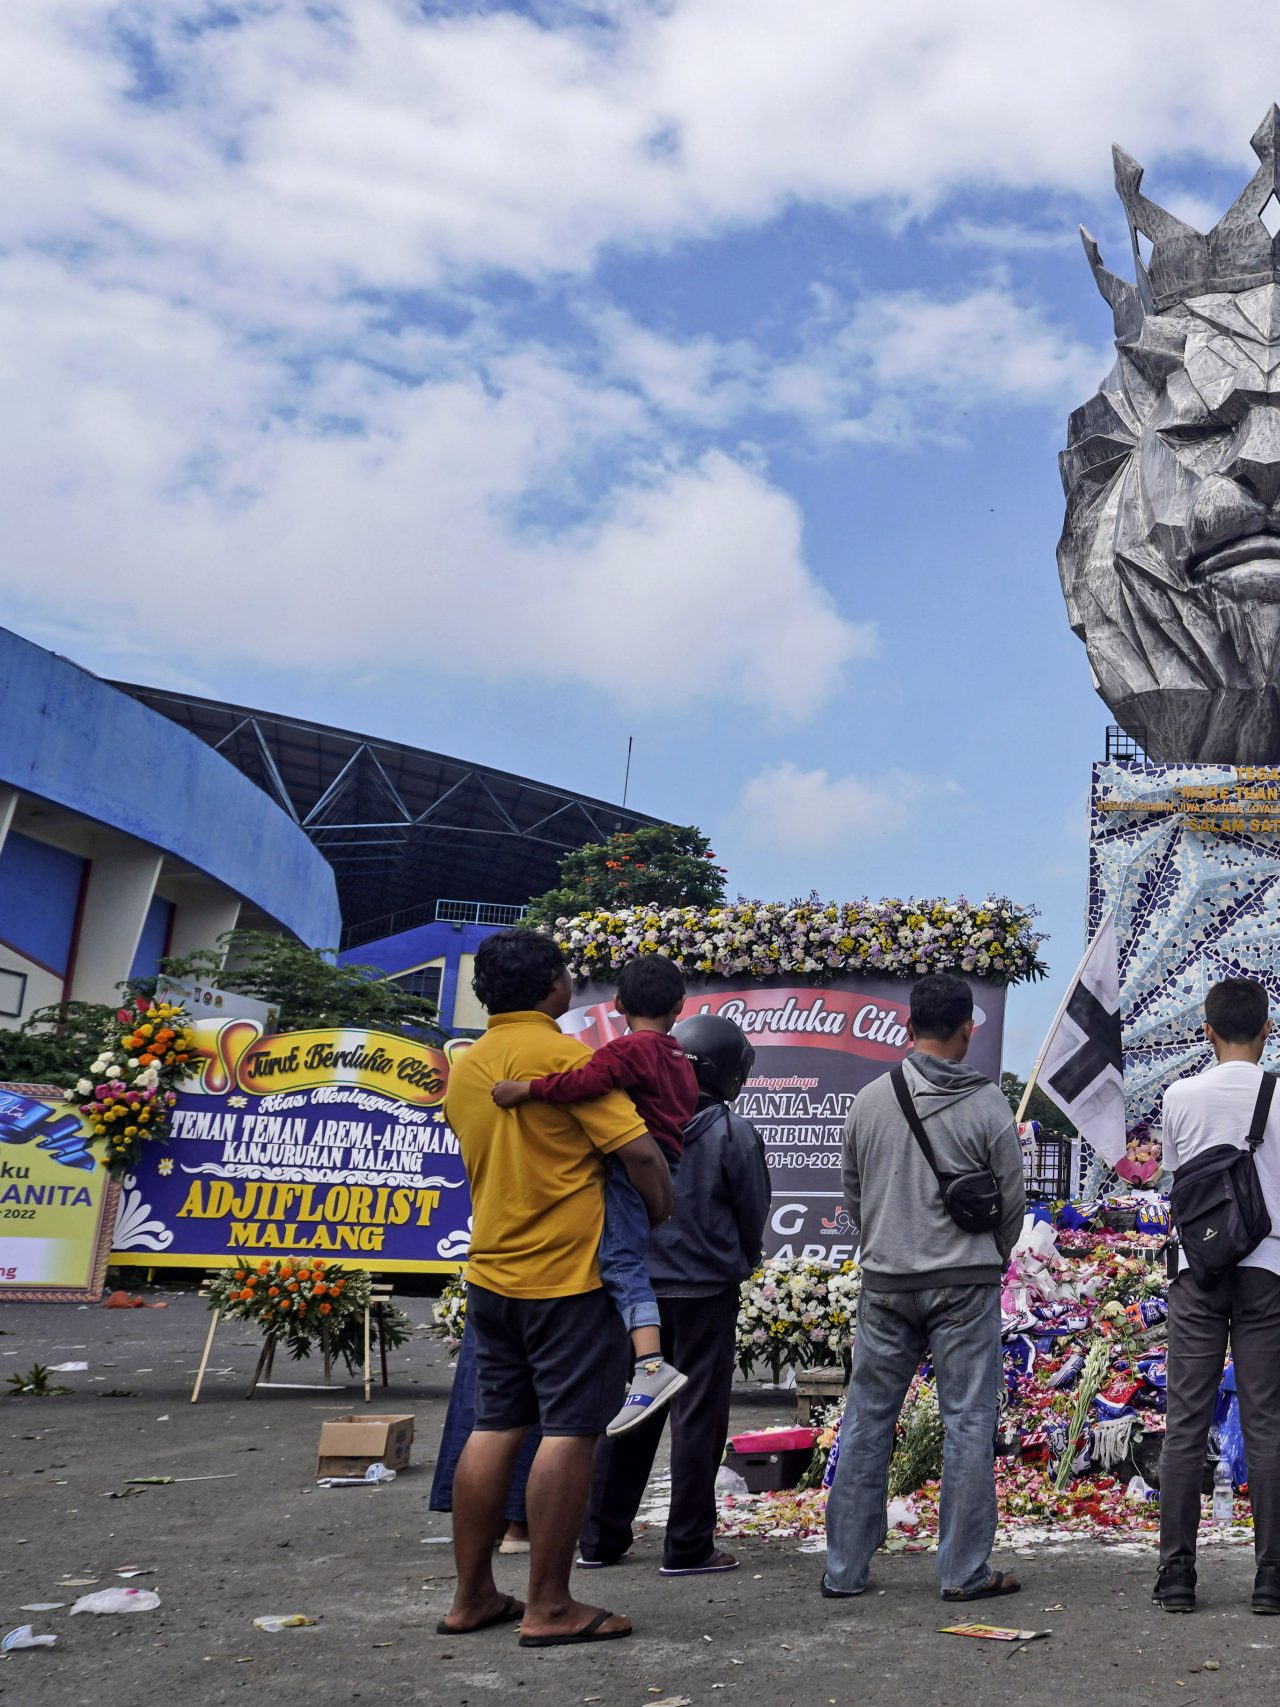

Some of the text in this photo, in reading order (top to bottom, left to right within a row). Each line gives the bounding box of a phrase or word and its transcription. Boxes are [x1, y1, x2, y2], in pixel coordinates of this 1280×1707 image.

[1236, 786, 1278, 800] THAN
[852, 1004, 909, 1047] Cita
[247, 1043, 445, 1094] Turut Berduka Cita
[744, 1075, 819, 1090] eninggalnya
[258, 1086, 428, 1124] Atas Meninggalnya
[169, 1110, 460, 1155] TEMAN TEMAN AREMA-AREMAN
[221, 1141, 424, 1173] KANJURUHAN MALANG
[765, 1151, 842, 1168] 01-10-202
[0, 1184, 93, 1207] ANITA
[176, 1179, 441, 1227] ADJIFLORIST
[4, 1208, 36, 1219] 2022
[226, 1222, 385, 1251] MALANG
